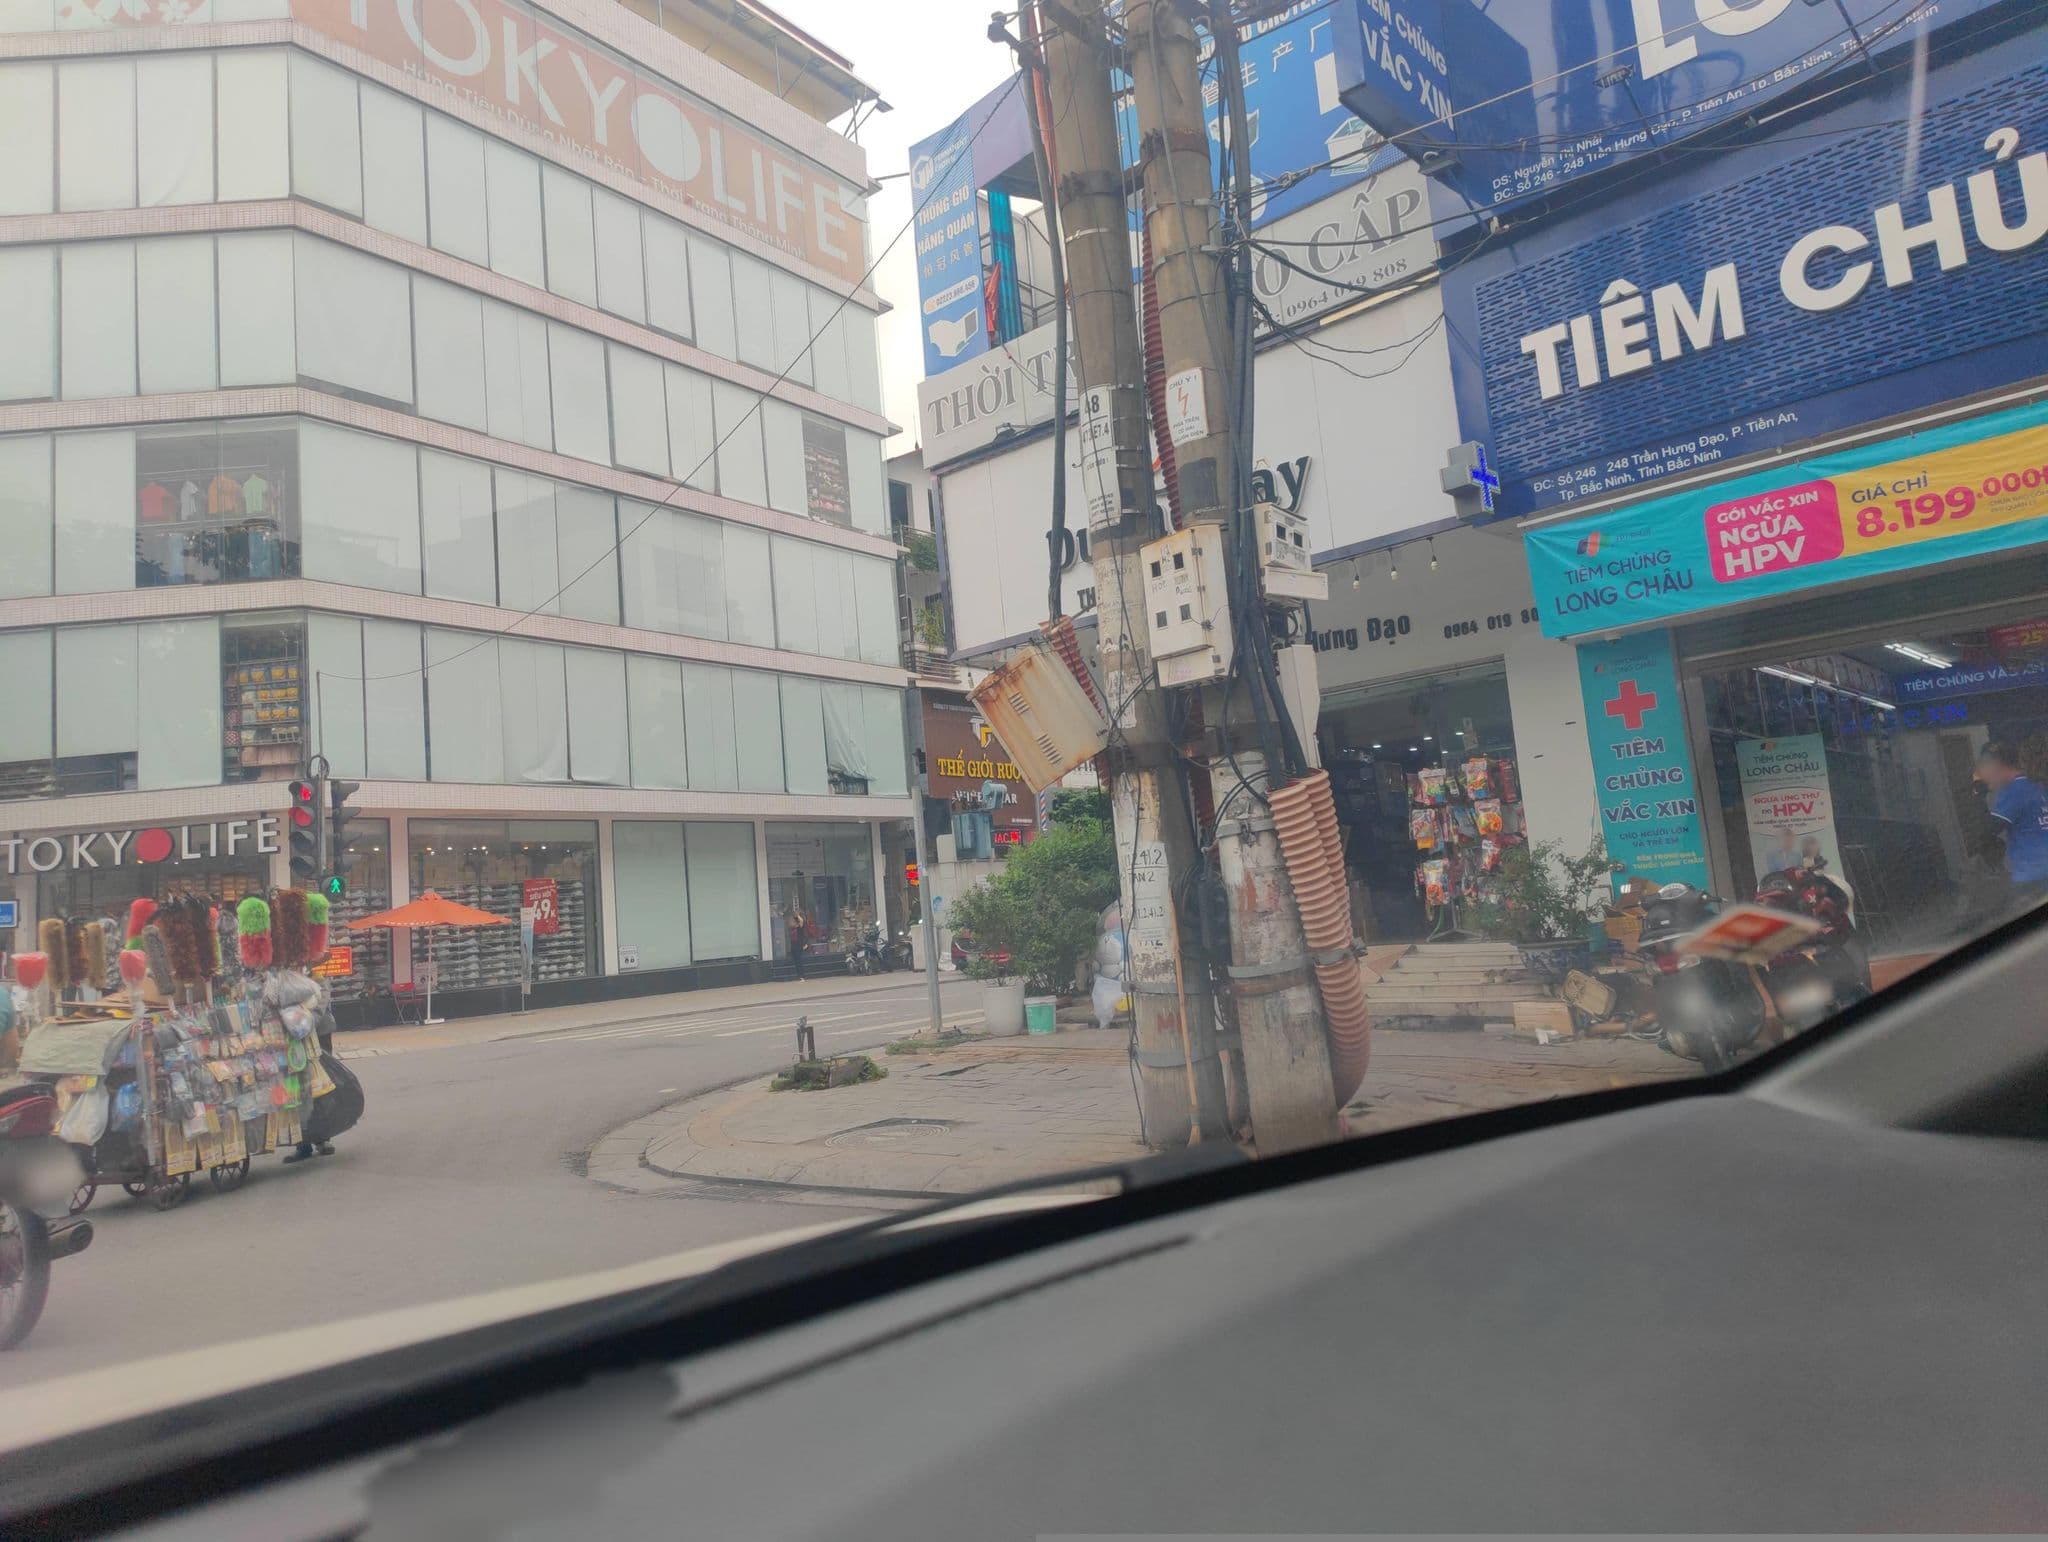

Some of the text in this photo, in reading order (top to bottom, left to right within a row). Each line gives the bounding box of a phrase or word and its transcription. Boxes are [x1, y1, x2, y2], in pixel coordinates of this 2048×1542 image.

[1395, 12, 1447, 75] CHỦNG
[1361, 19, 1454, 131] VẮC XIN
[1534, 169, 1554, 187] 246
[1563, 156, 1585, 175] 248
[1614, 129, 1648, 151] Hưng
[1773, 63, 1800, 84] Bắc
[1492, 175, 1512, 190] DS:
[1307, 173, 1422, 276] CẤP
[1286, 290, 1329, 318] 0964
[1372, 258, 1408, 283] 808
[1520, 262, 1745, 401] TIÊM
[927, 362, 1017, 438] THỜI
[1533, 478, 1555, 494] ĐC:
[1558, 469, 1574, 487] Số
[1575, 466, 1597, 484] 246
[1606, 457, 1630, 473] 248
[1631, 449, 1659, 467] Trần
[1661, 440, 1697, 461] Hưng
[1698, 431, 1729, 450] Đạo,
[1731, 425, 1744, 438] P.
[1777, 411, 1800, 428] An,
[1558, 489, 1578, 502] Tp.
[1580, 478, 1604, 496] Bắc
[1604, 471, 1637, 490] Ninh,
[1667, 455, 1692, 474] Bắc
[1693, 447, 1722, 466] Ninh
[1851, 469, 1929, 504] GIÁ CHỈ
[1717, 490, 1819, 524] GÓI VẮC XIN
[1720, 514, 1804, 549] NGỪA
[1564, 549, 1672, 585] TIÊM CHỦNG
[1724, 535, 1805, 577] HPV
[1555, 568, 1693, 615] LONG CHÂU
[1366, 613, 1411, 646] Đạo
[1487, 609, 1513, 632] 019
[1904, 678, 1934, 693] TIÊM
[1936, 669, 1985, 689] CHỦNG
[938, 749, 965, 777] THẾ
[968, 753, 994, 778] GIỚI
[1611, 737, 1665, 760] TIÊM
[1605, 766, 1685, 792] CHỦNG
[1746, 761, 1821, 777] LONG CHÂU
[1604, 797, 1697, 824] VẮC XIN
[1772, 800, 1814, 817] HPV
